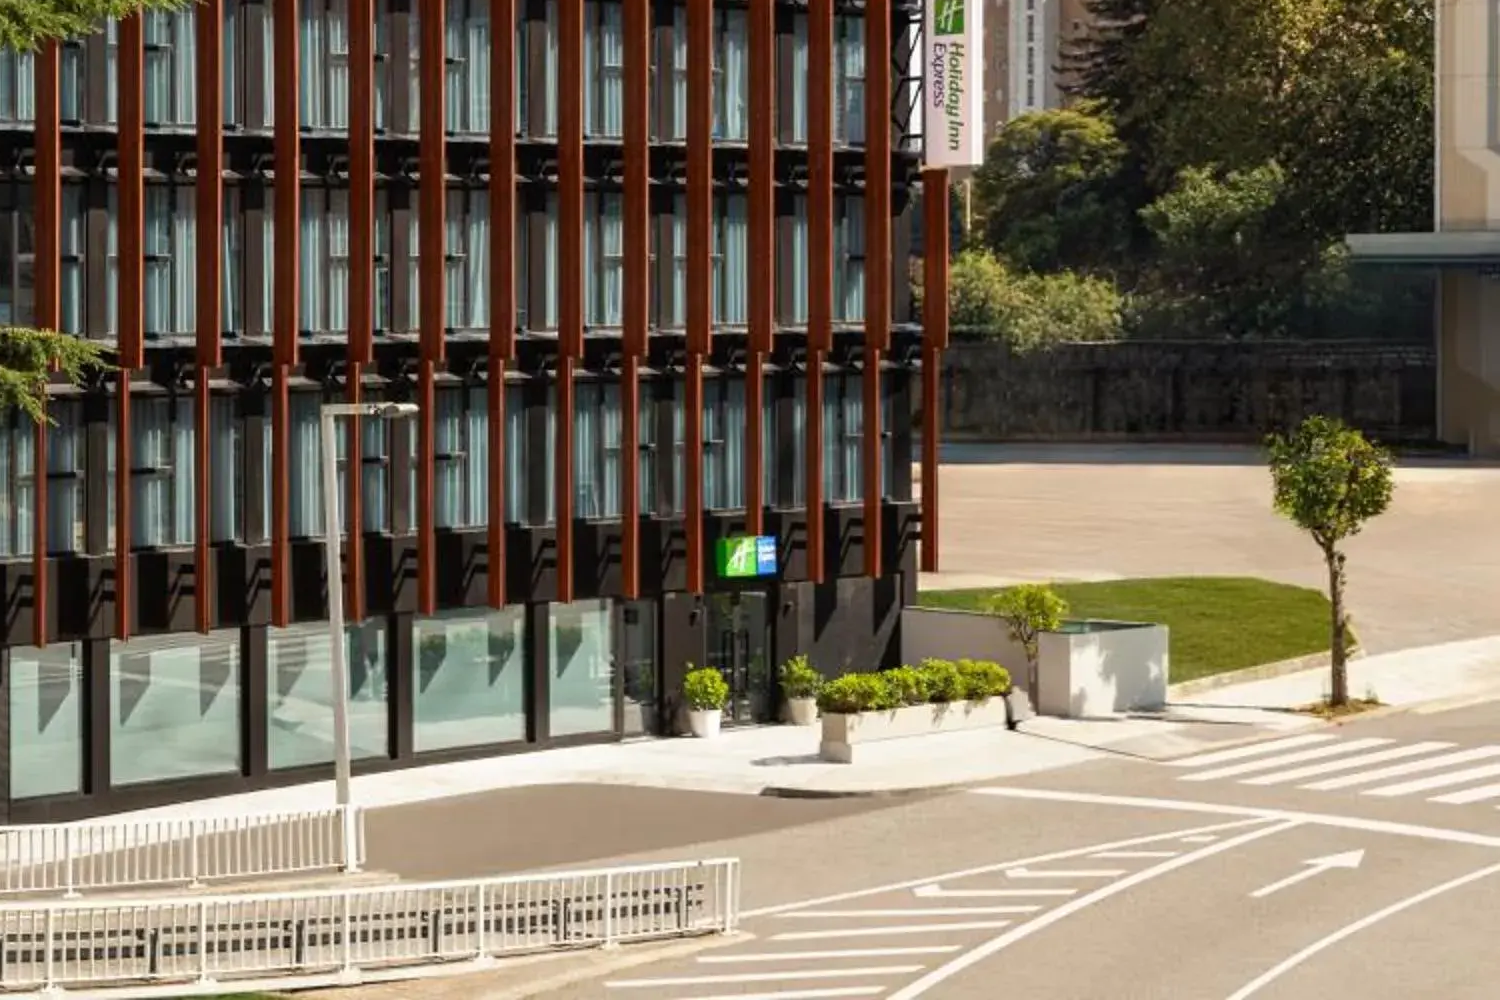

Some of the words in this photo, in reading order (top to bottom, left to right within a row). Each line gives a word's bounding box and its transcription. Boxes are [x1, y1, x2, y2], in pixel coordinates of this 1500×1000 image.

[930, 42, 947, 108] Express
[945, 41, 965, 116] Holiday
[948, 119, 965, 151] Inn
